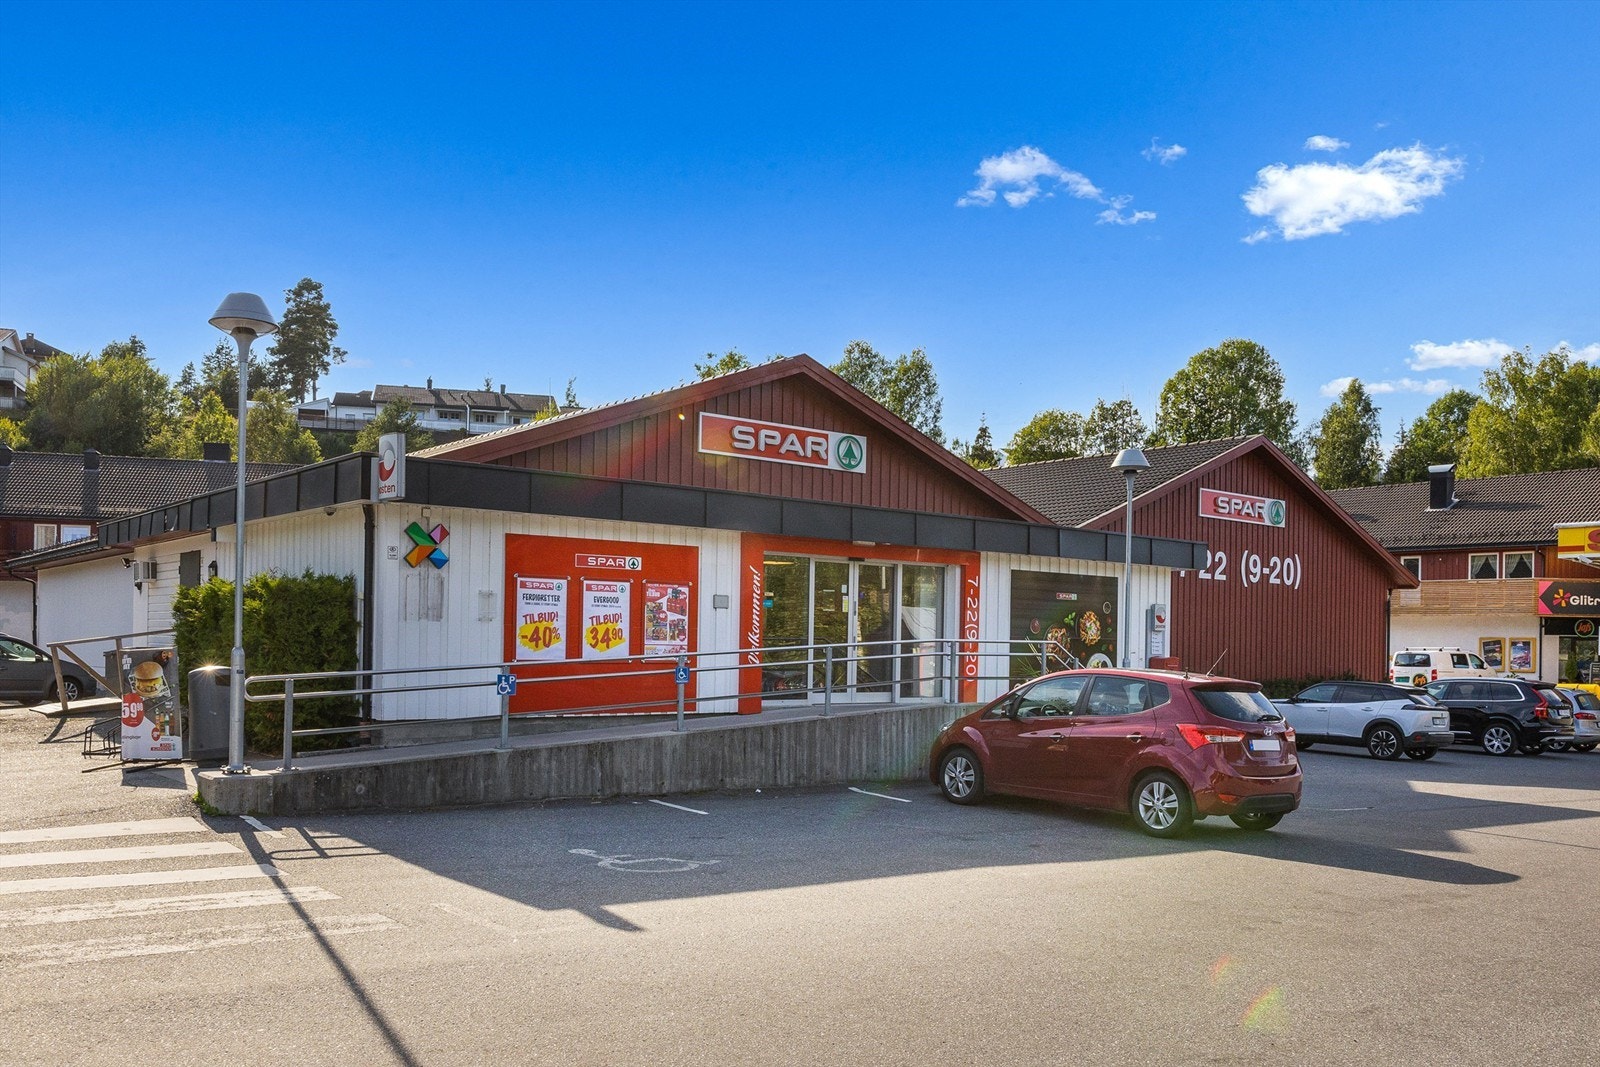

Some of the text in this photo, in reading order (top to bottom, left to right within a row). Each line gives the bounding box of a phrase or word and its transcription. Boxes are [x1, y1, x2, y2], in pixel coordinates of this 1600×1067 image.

[732, 425, 827, 459] SPAR
[1217, 496, 1265, 518] SPAR
[587, 557, 625, 567] SPAR
[1180, 550, 1301, 590] 22 (9-20)
[522, 593, 561, 602] FERDIGRETTER
[522, 611, 559, 625] TILBUD!
[589, 613, 623, 626] TILBUD!
[747, 565, 760, 664] Velkommen!
[521, 625, 561, 648] -40%
[509, 676, 516, 684] P
